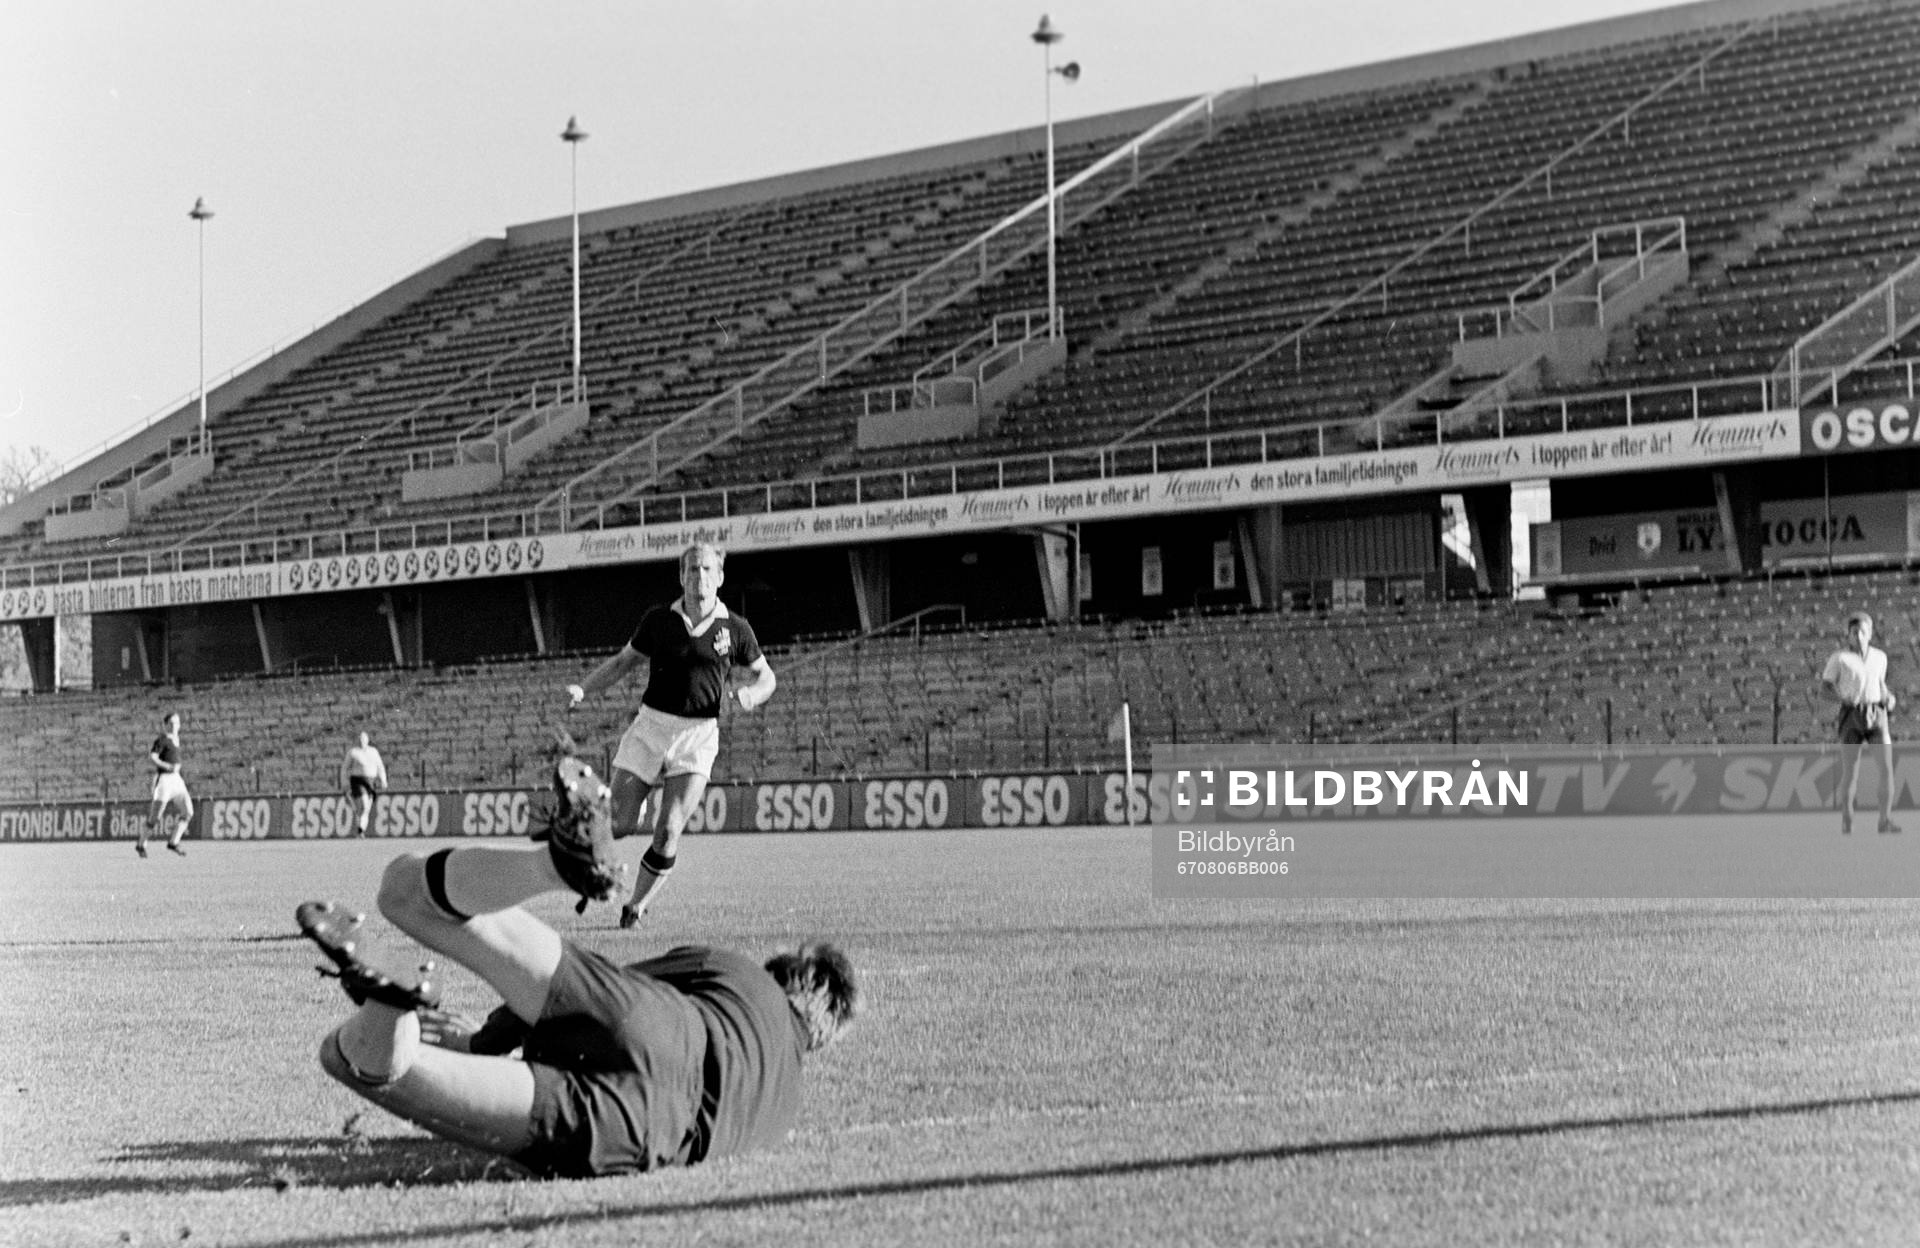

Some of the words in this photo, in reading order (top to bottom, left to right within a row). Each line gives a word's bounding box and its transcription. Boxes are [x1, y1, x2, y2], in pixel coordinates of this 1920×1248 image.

[1811, 404, 1920, 450] OSC
[1538, 443, 1588, 467] toppen
[1611, 433, 1647, 457] efter
[1251, 472, 1274, 490] den
[1277, 470, 1313, 489] stora
[813, 515, 833, 533] den
[835, 514, 864, 531] stora
[1044, 491, 1083, 515] toppen
[755, 784, 834, 830] ESSO
[865, 779, 949, 828] ESSO
[981, 775, 1069, 826] ESSO
[1104, 773, 1197, 825] ESSO
[1536, 762, 1631, 814] TV
[212, 799, 271, 839] ESSO
[291, 797, 351, 838] ESSO
[375, 794, 439, 837] ESSO
[463, 792, 530, 836] ESSO
